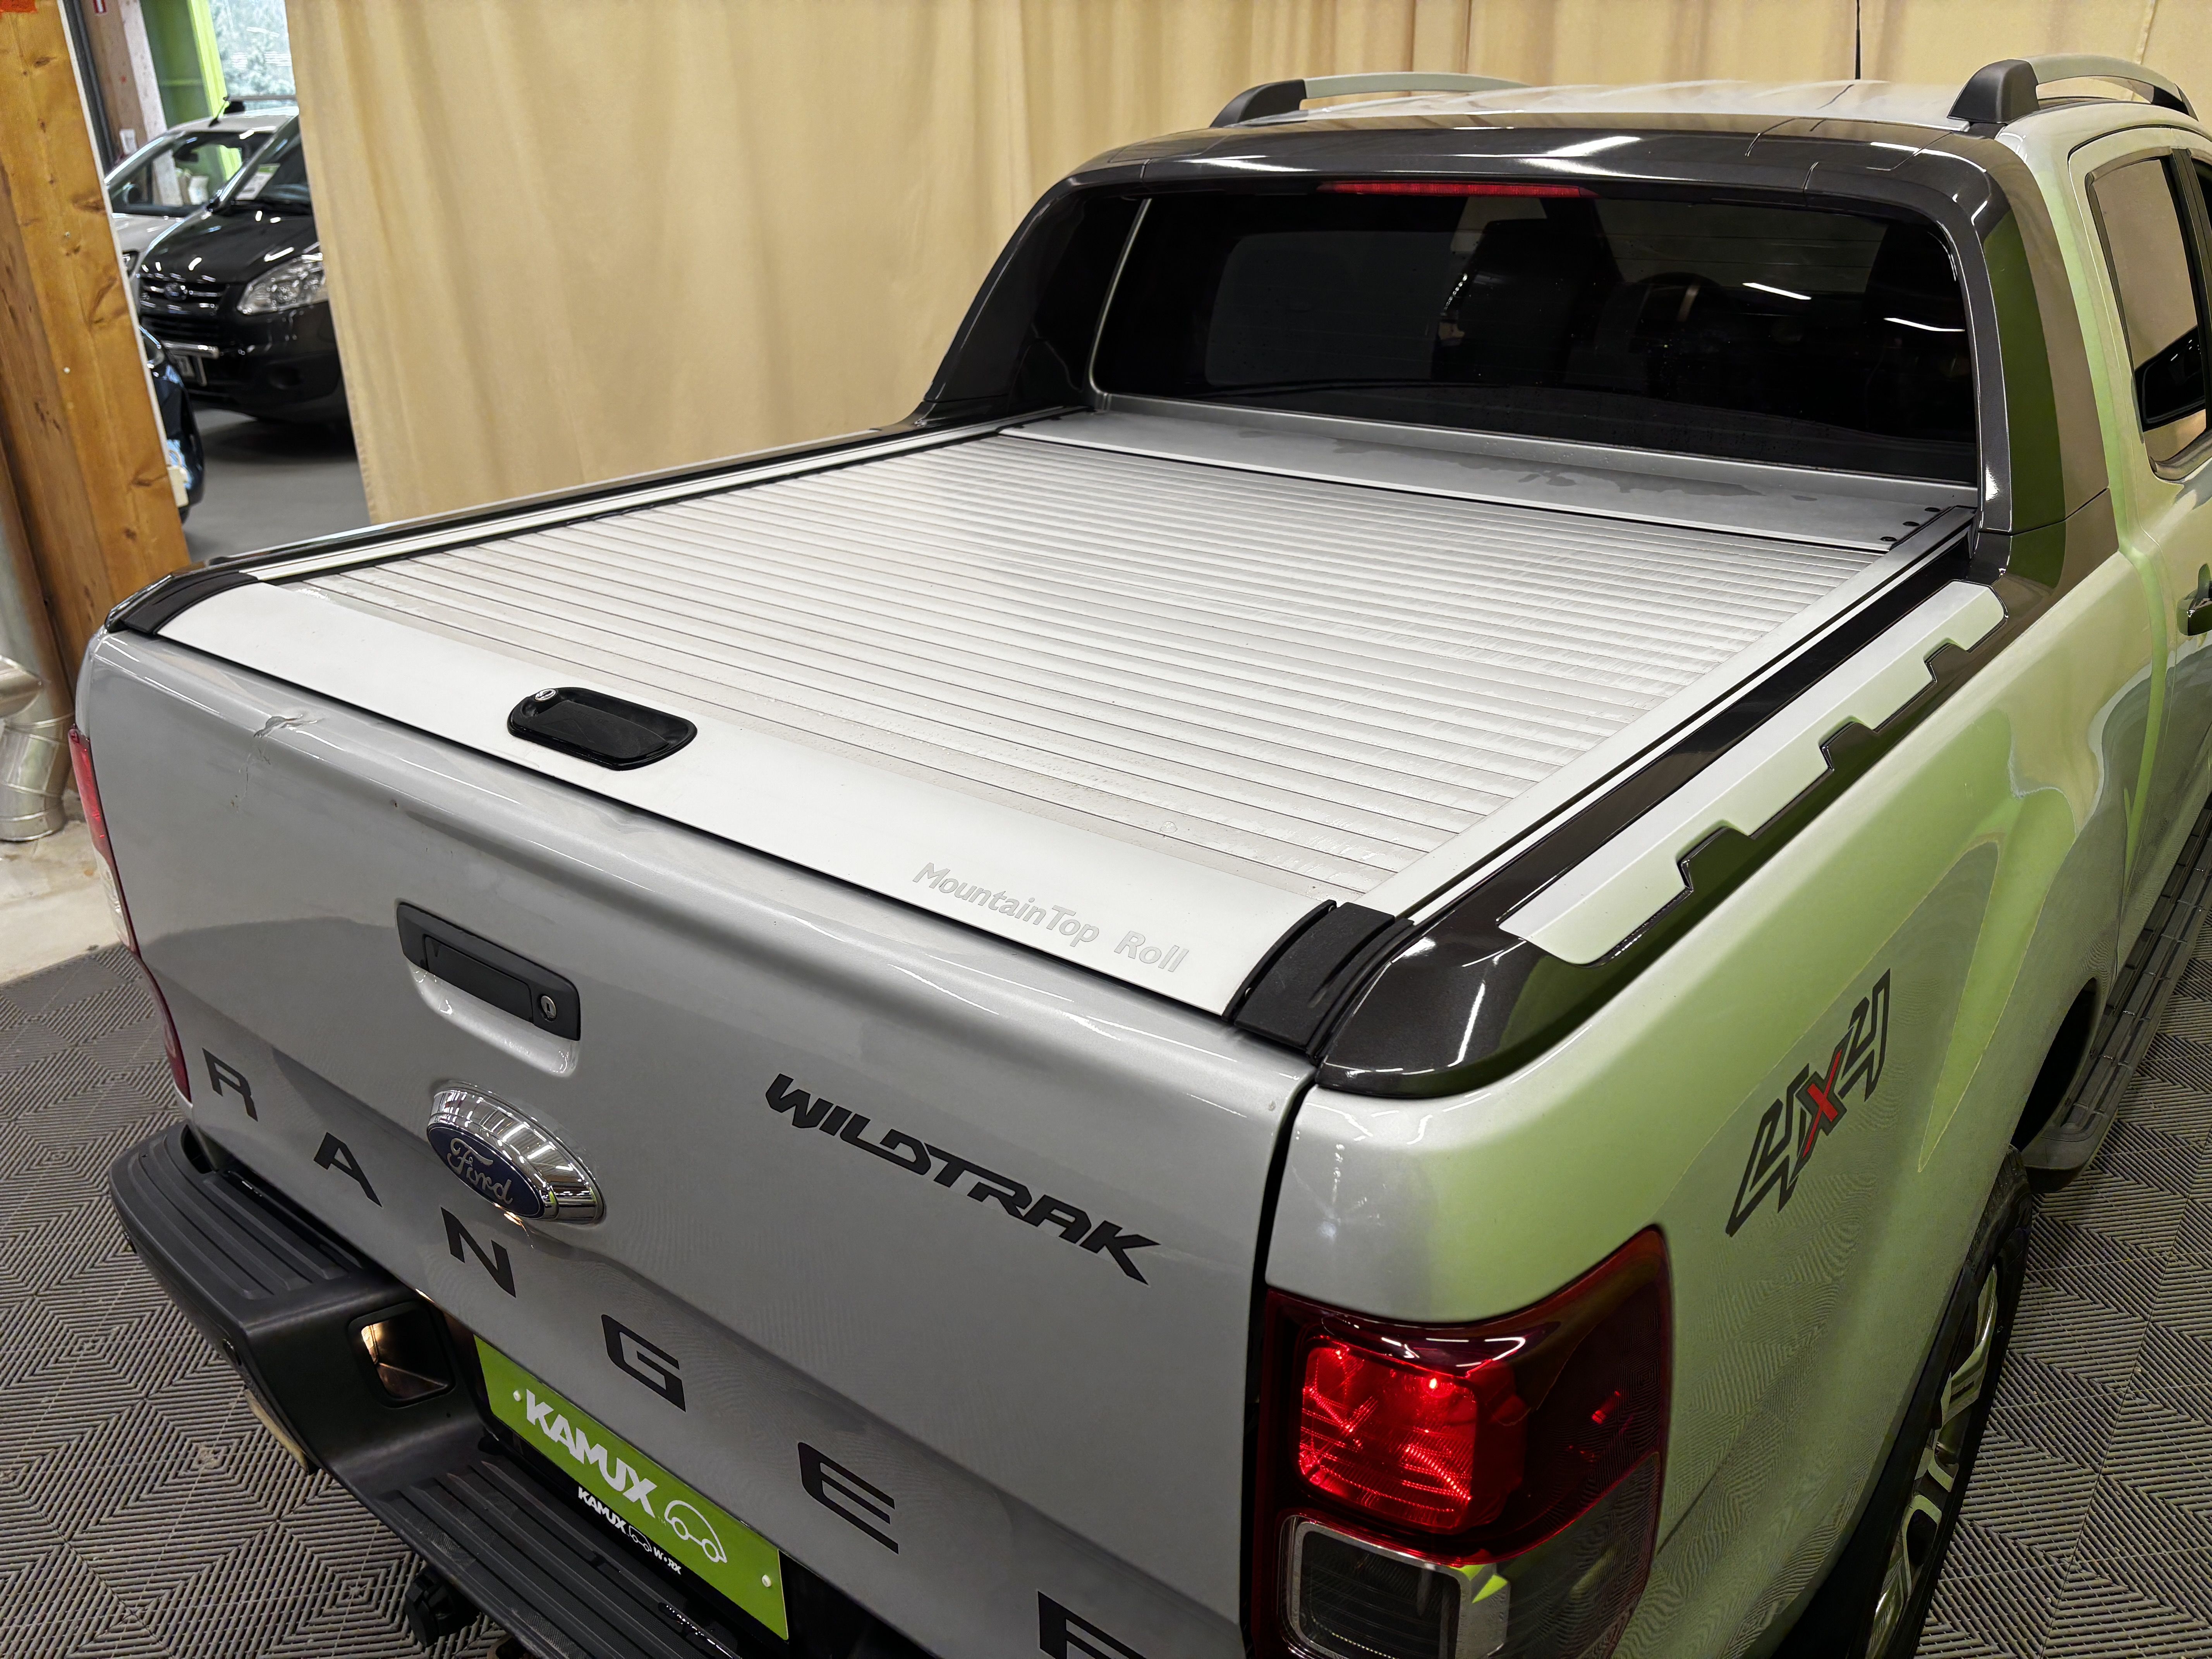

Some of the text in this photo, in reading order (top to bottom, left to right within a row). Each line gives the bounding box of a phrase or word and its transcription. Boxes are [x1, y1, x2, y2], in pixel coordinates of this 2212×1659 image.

[1114, 930, 1189, 973] Roll
[447, 1138, 513, 1205] Ford
[765, 1073, 1161, 1286] WILDTRAK
[526, 1389, 658, 1518] KAMUX
[578, 1486, 627, 1534] KAMUX
